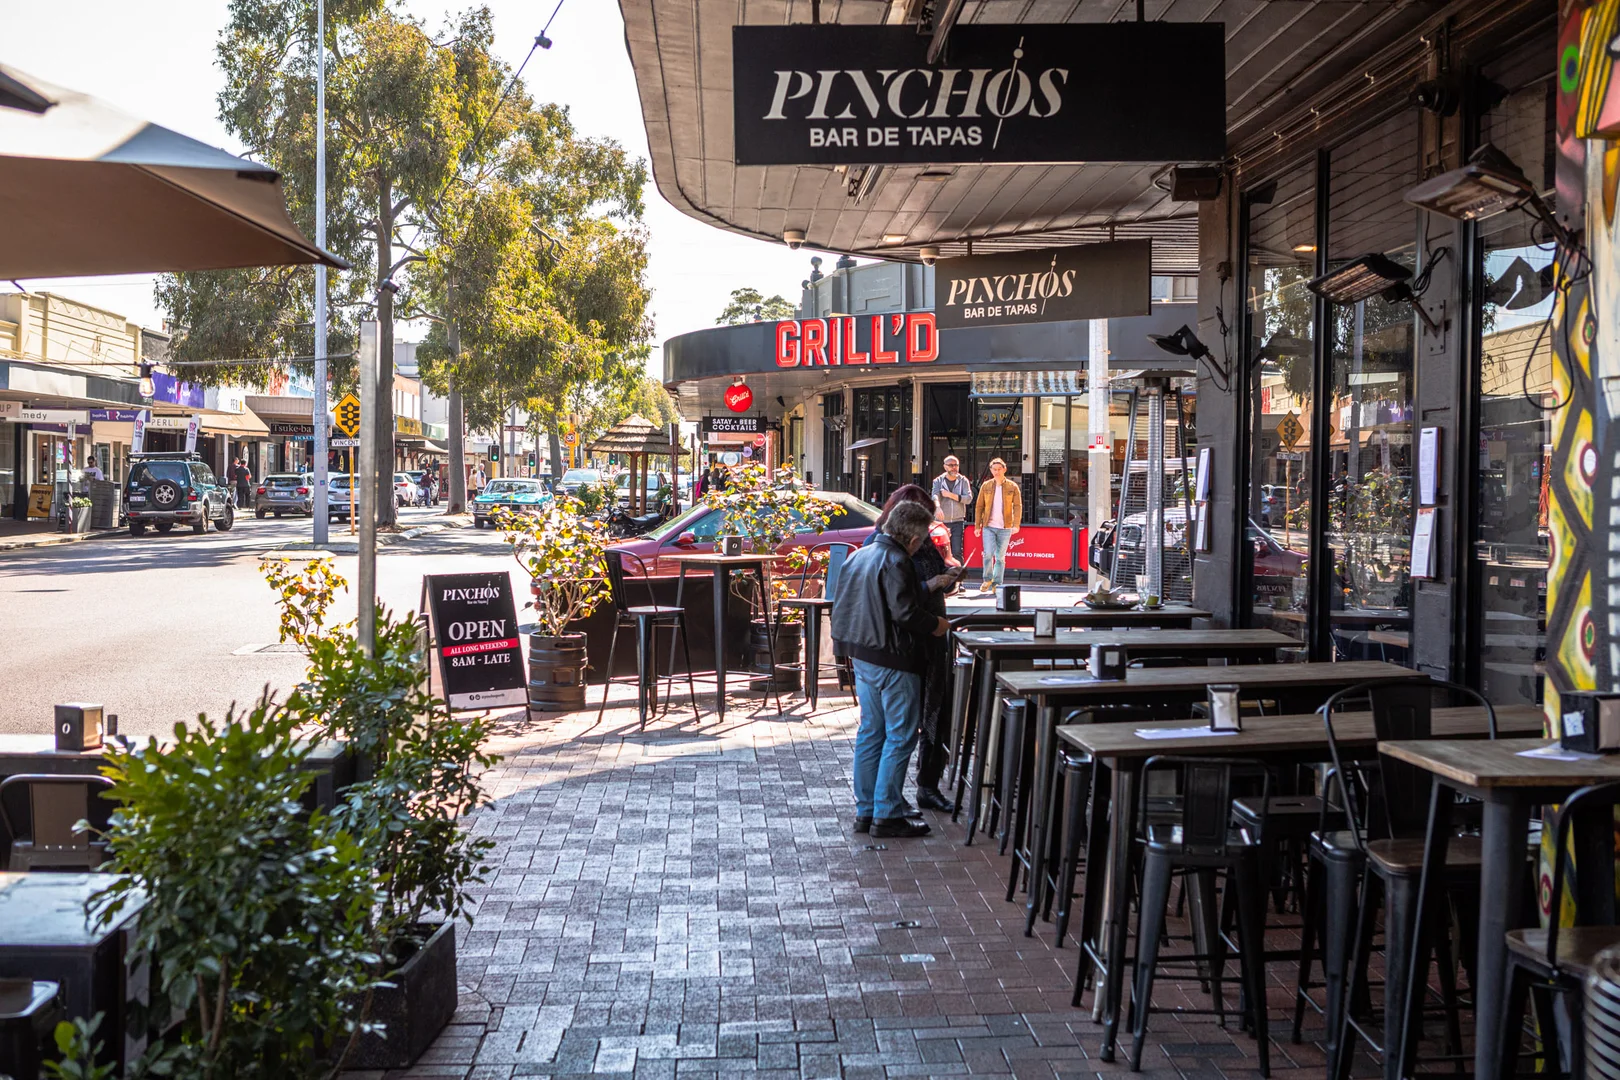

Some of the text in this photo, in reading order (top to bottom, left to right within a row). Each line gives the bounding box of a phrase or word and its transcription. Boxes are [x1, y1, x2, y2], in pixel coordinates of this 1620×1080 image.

[762, 52, 1069, 120] PINCHOS
[810, 126, 982, 147] BAR DE TAPAS
[945, 261, 1077, 306] PINCHOS
[964, 303, 1038, 319] BAR DE TAPAS
[776, 313, 939, 367] GRILL'D
[21, 412, 48, 421] medy
[442, 584, 500, 601] PINCHOS
[448, 619, 506, 641] OPEN
[450, 641, 509, 655] ALL LONG WEEKEND
[452, 657, 476, 667] 8AM
[484, 653, 511, 665] LATE
